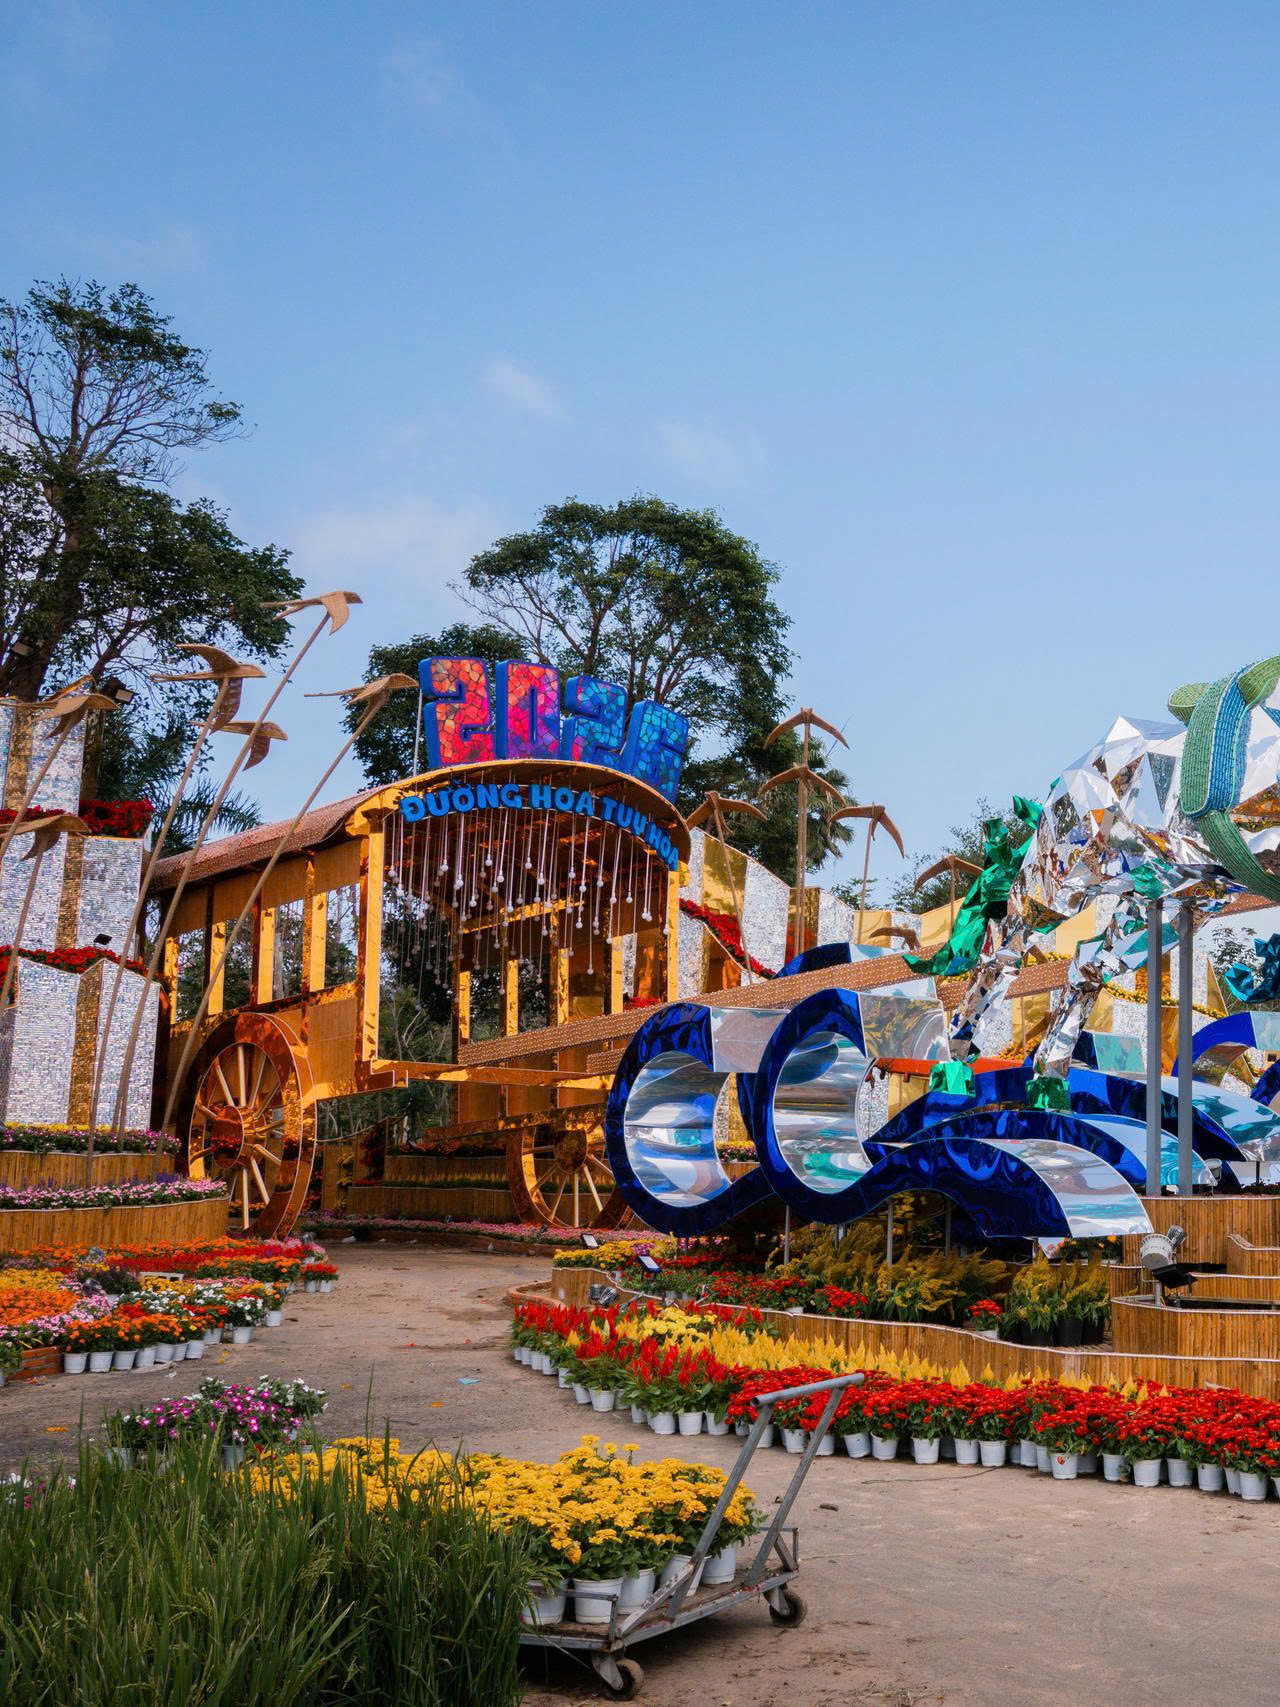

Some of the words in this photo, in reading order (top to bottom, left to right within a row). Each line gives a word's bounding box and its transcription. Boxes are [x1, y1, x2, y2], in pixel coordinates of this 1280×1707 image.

[418, 656, 690, 804] 2026
[400, 778, 523, 822] ĐƯỜNG
[530, 783, 595, 817] HOA
[601, 796, 647, 837] TUY
